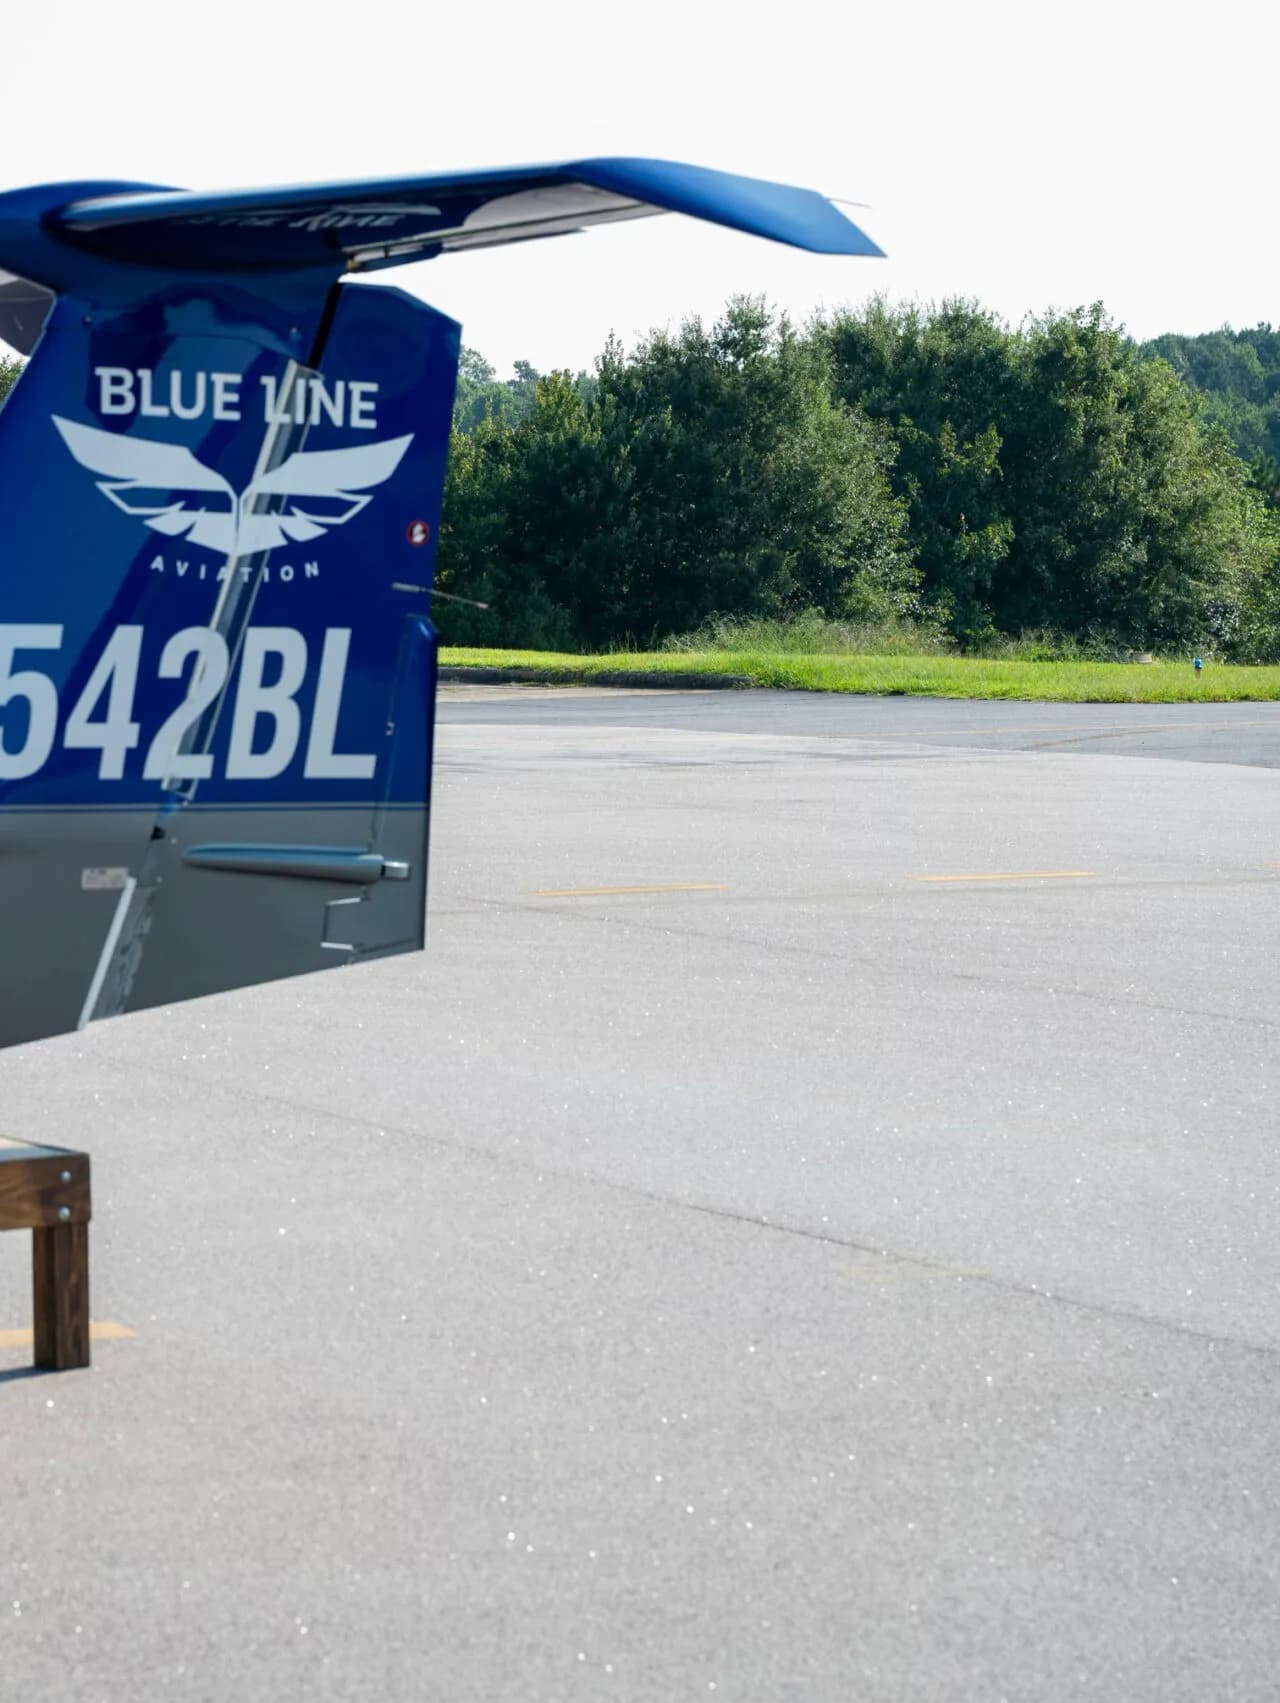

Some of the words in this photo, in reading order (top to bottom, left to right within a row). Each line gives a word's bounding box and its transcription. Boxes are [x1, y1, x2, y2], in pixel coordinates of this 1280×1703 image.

[94, 366, 242, 421] BLUE
[260, 375, 379, 430] LINE
[150, 555, 320, 583] AVIATION
